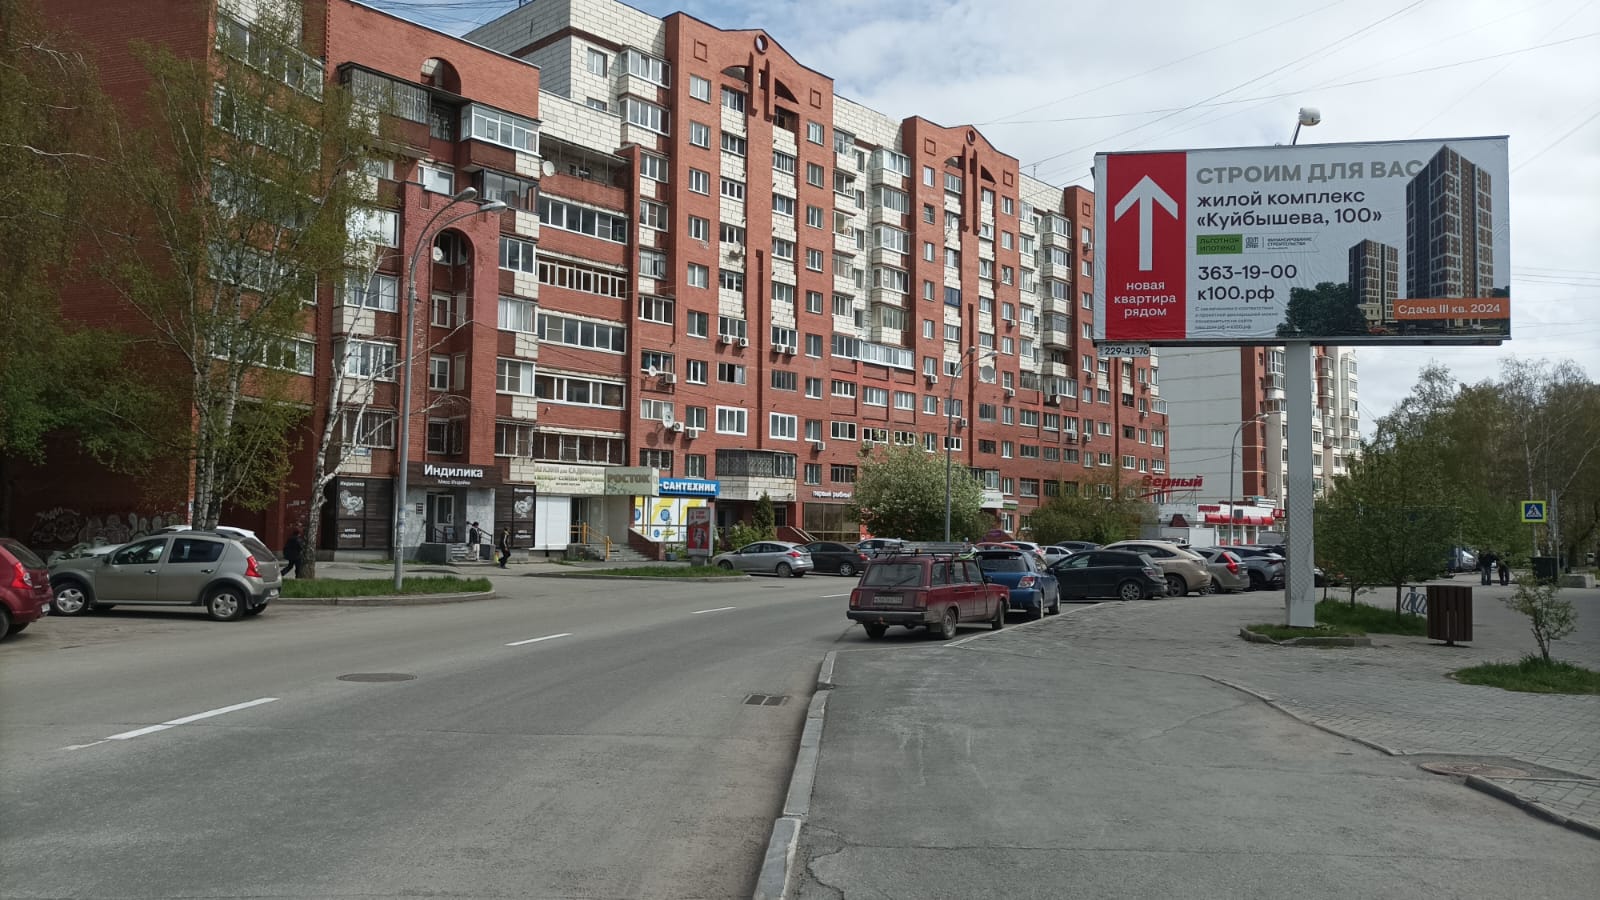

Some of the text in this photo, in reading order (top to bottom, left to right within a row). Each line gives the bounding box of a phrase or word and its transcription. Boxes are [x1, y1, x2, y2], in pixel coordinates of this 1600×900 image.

[1196, 159, 1424, 184] СТРОИМ ДЛЯ ВАС
[1196, 190, 1365, 208] жилой комплекс
[1196, 207, 1382, 230] «Куйбышева, 100»
[1197, 265, 1298, 280] 363-19-00
[1126, 281, 1165, 290] новая
[1114, 293, 1177, 306] квартира
[1197, 285, 1275, 303] к100.рф
[1124, 307, 1167, 318] рядом
[1398, 304, 1437, 315] Сдача
[1451, 305, 1468, 313] кв.
[1470, 303, 1501, 313] 2024
[1105, 346, 1149, 355] 229-41-76
[424, 464, 484, 478] Индилика
[607, 473, 651, 484] РОСТОК
[1142, 475, 1204, 489] Верный
